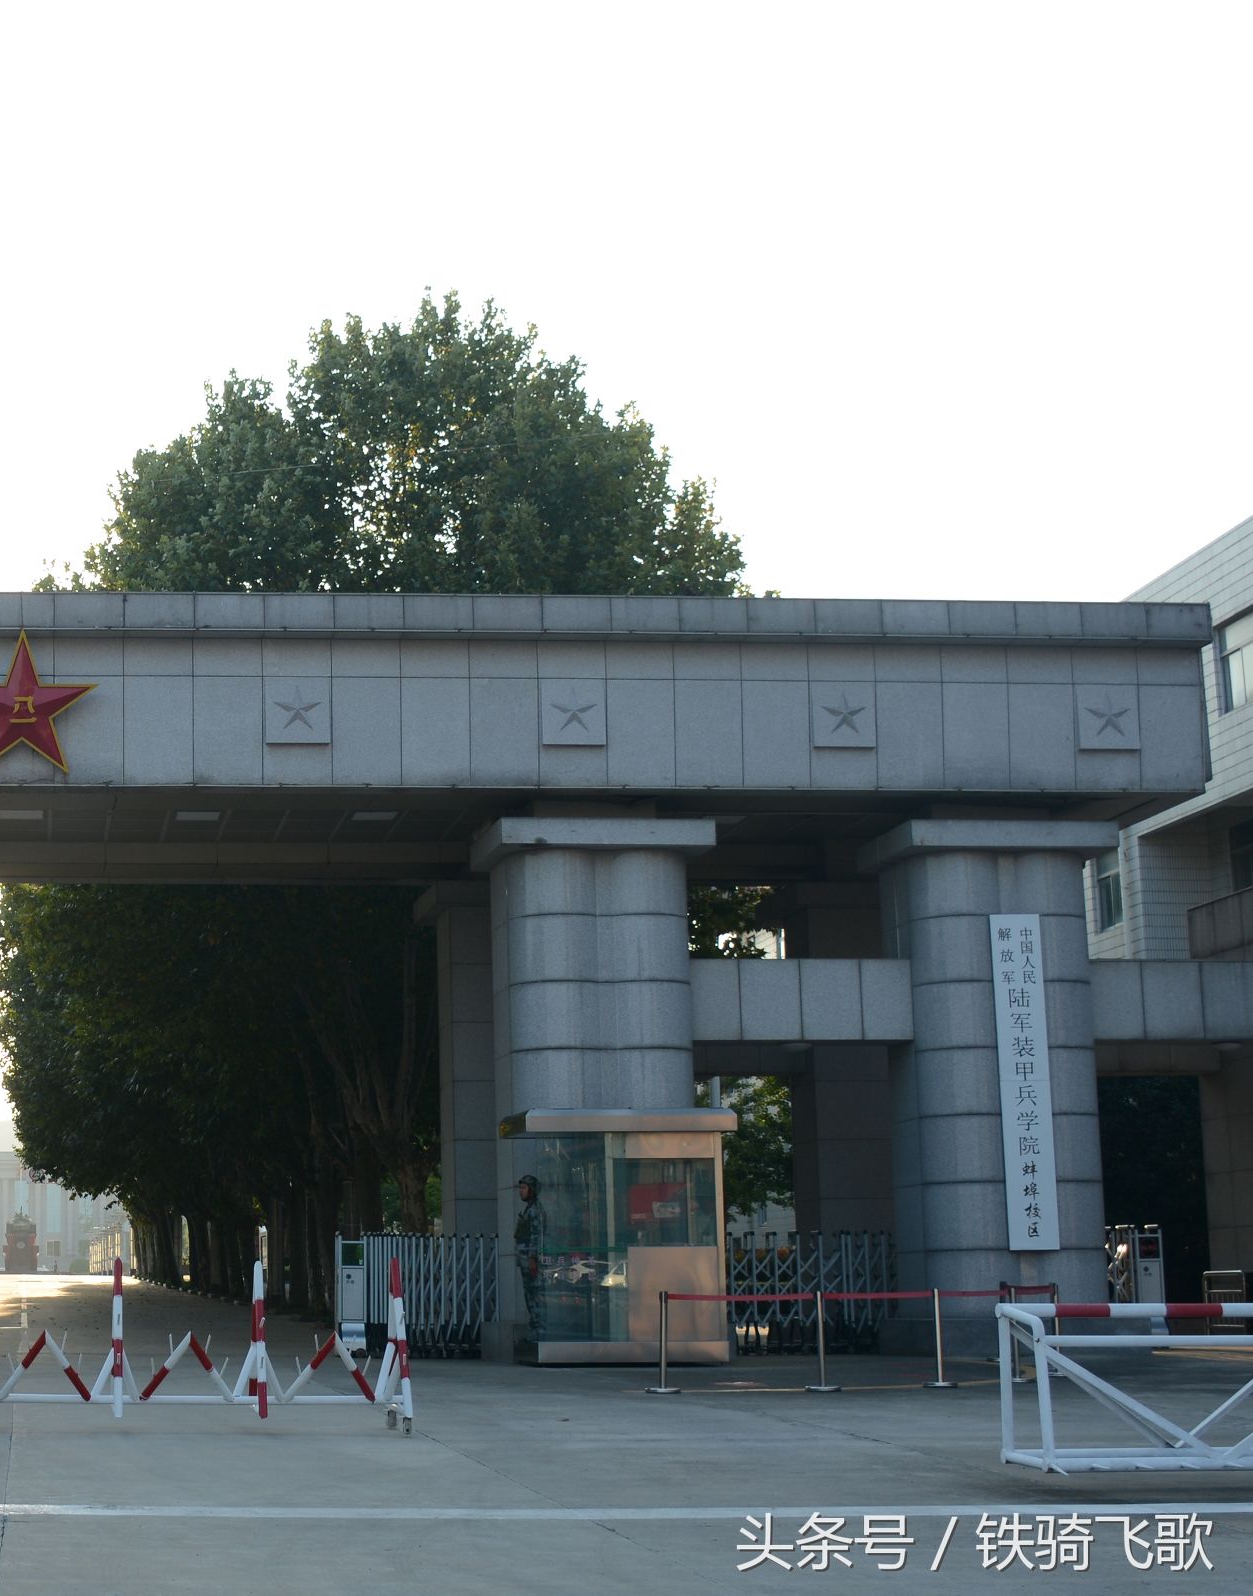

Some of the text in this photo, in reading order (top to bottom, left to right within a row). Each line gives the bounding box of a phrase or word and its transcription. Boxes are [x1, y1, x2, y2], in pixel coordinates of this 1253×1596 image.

[997, 927, 1016, 985] 解放军
[1019, 926, 1036, 984] 中国人民
[1008, 987, 1041, 1157] 陆军装甲兵学院
[1022, 1160, 1042, 1238] 蚌埠校区
